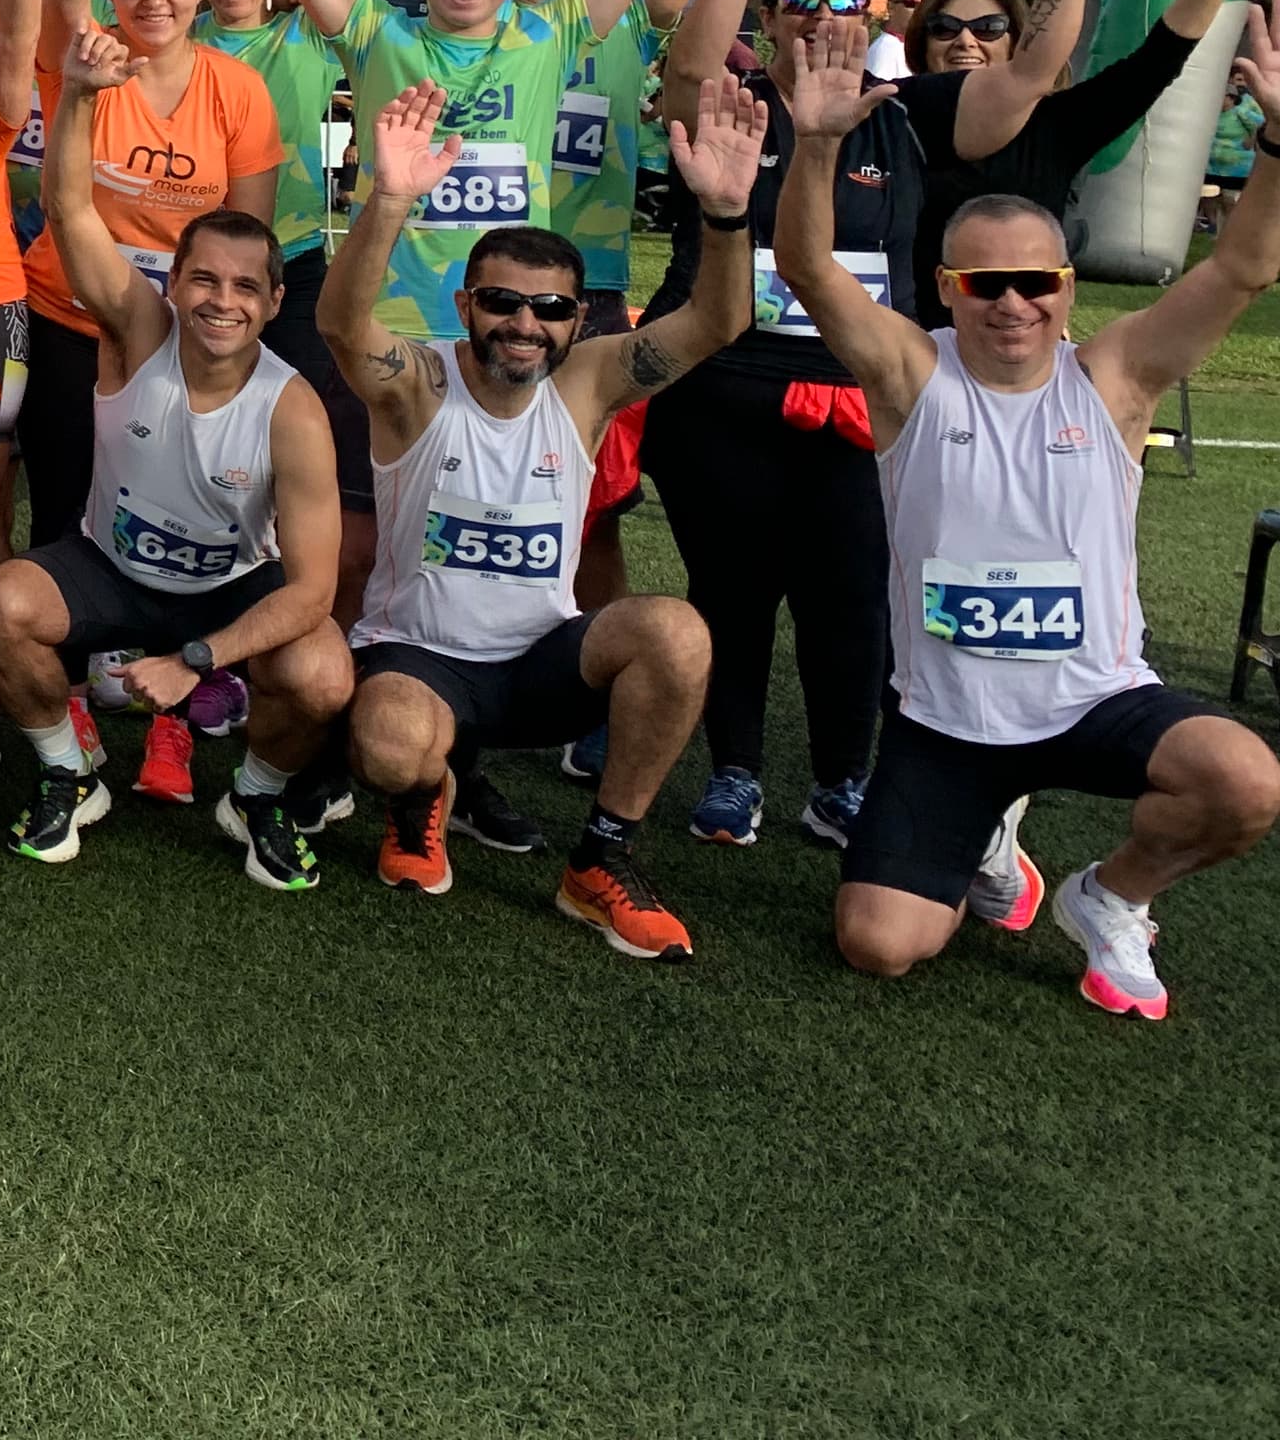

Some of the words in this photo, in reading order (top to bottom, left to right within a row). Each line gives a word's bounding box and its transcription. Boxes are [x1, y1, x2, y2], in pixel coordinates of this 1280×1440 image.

[436, 84, 515, 128] ESI
[480, 129, 507, 140] bem
[143, 185, 206, 208] batista
[153, 177, 220, 196] marcelo
[431, 175, 528, 214] 685
[133, 253, 157, 265] SESI
[484, 511, 513, 521] SESI
[136, 530, 233, 572] 645
[454, 528, 559, 570] 539
[986, 571, 1018, 581] SESI
[960, 597, 1081, 640] 344
